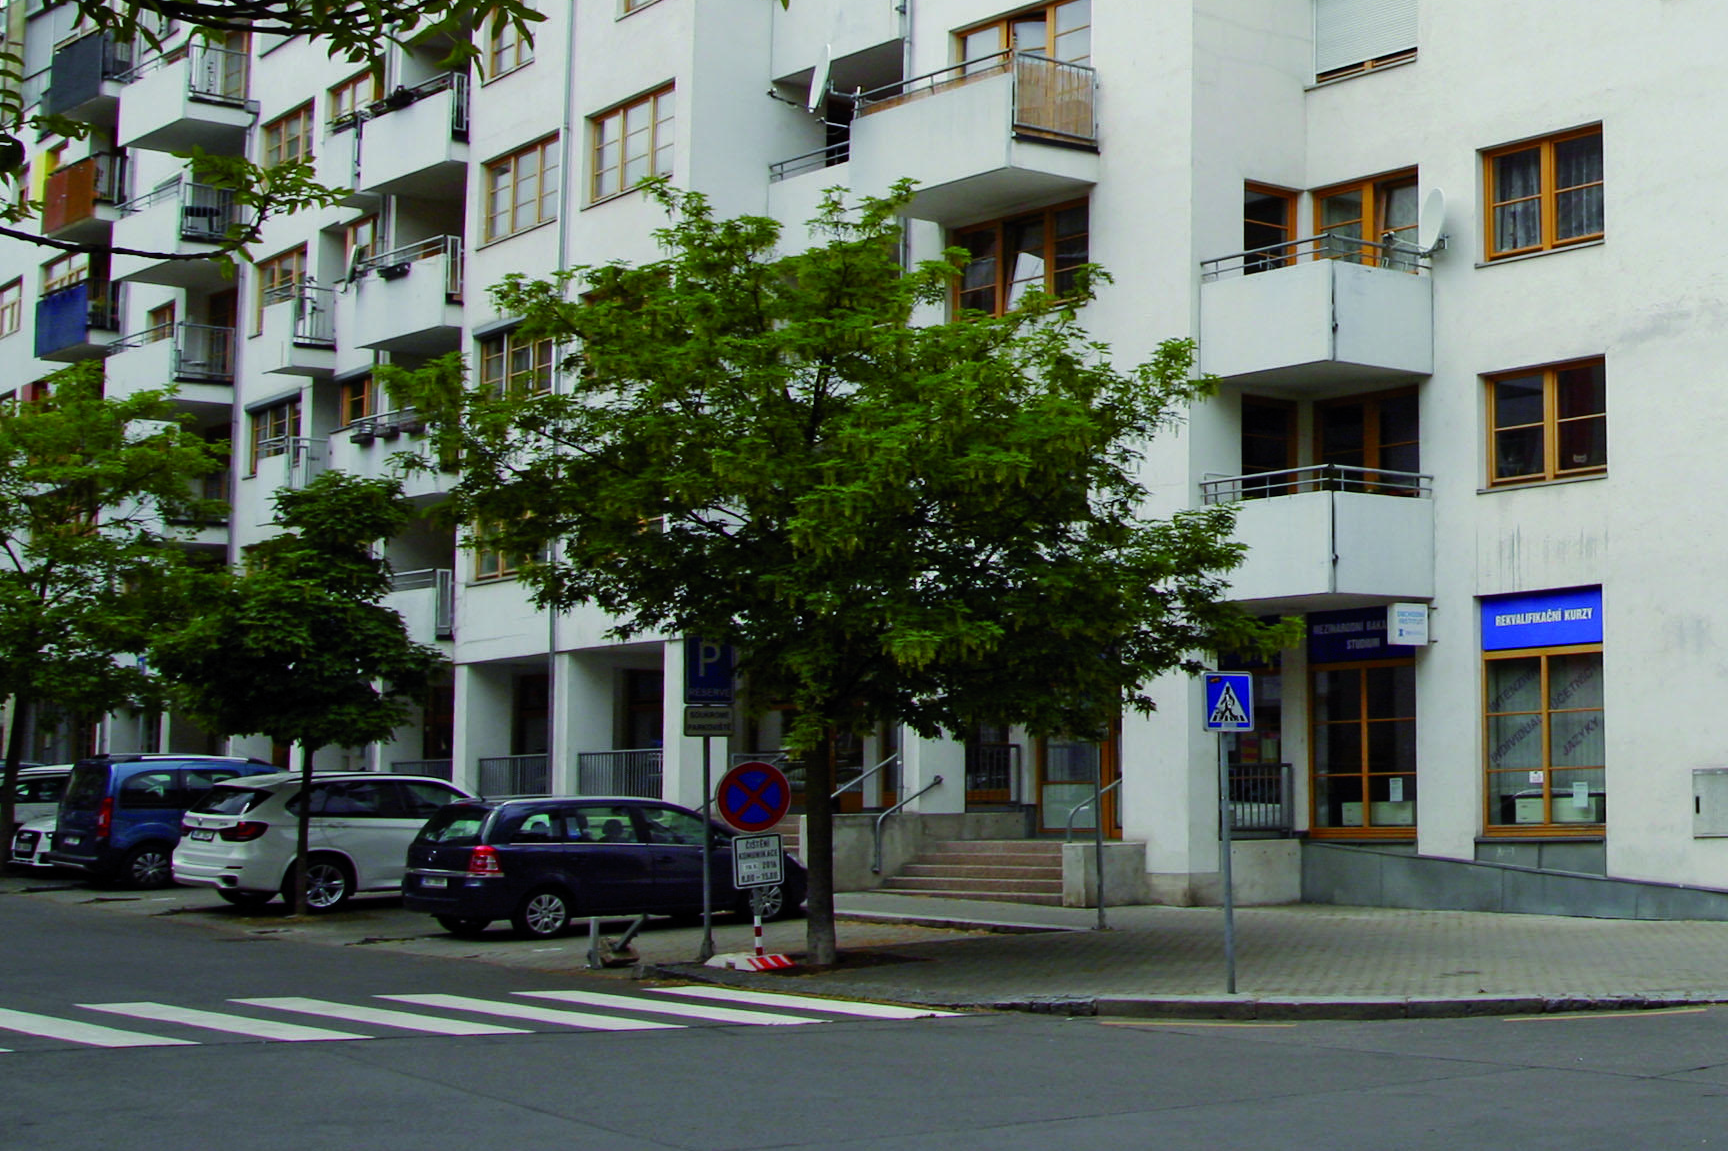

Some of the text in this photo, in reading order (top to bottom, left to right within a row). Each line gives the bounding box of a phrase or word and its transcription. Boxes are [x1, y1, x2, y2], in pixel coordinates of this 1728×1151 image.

[1495, 607, 1593, 627] REKVALIFIKAČNÍ KURZY
[699, 641, 721, 677] P
